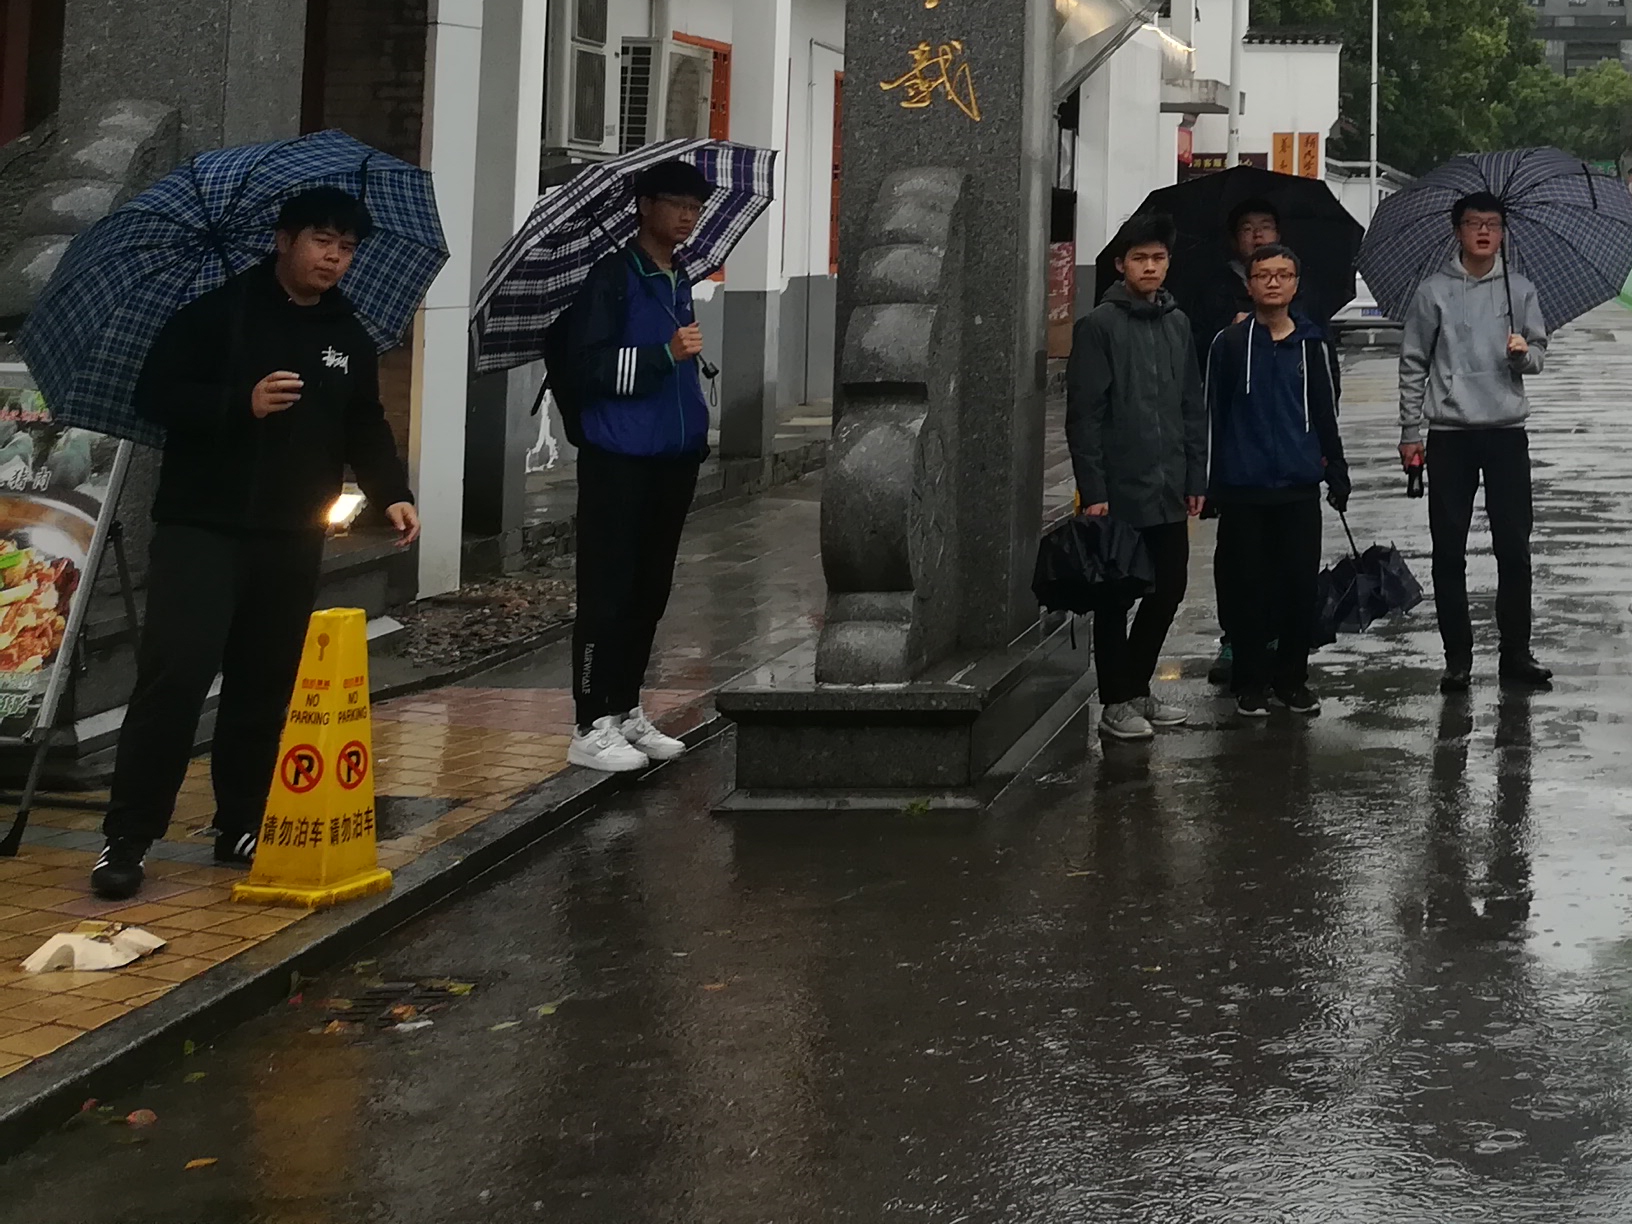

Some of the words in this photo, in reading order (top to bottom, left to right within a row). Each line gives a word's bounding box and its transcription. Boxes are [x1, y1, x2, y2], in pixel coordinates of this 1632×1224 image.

[305, 693, 320, 707] NO
[347, 690, 358, 705] NO
[290, 709, 330, 726] PARKING
[337, 705, 367, 724] PARKING
[262, 814, 325, 848] 请勿泊车
[329, 806, 374, 846] 请勿泊车
